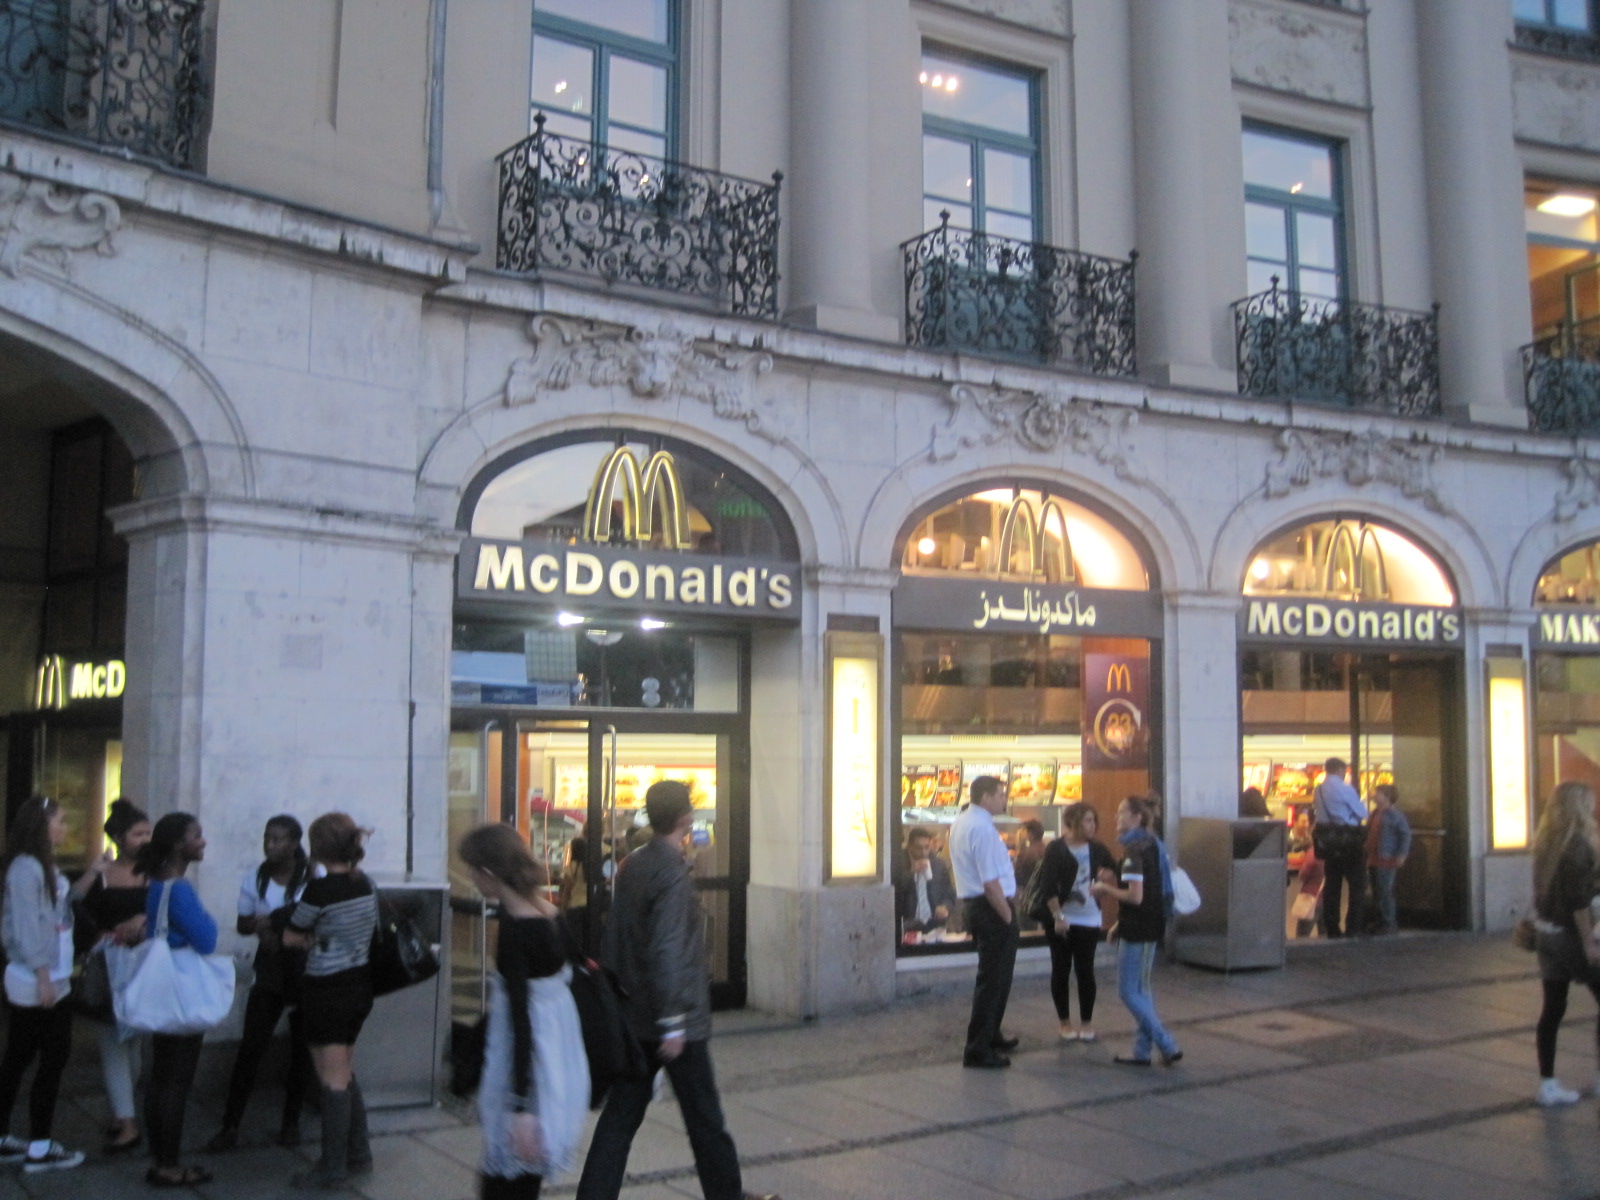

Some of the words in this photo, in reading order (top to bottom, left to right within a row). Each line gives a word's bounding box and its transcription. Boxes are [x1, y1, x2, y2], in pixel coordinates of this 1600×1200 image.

[474, 544, 793, 609] McDonald's
[1247, 600, 1460, 642] McDonald's
[69, 660, 125, 698] McD
